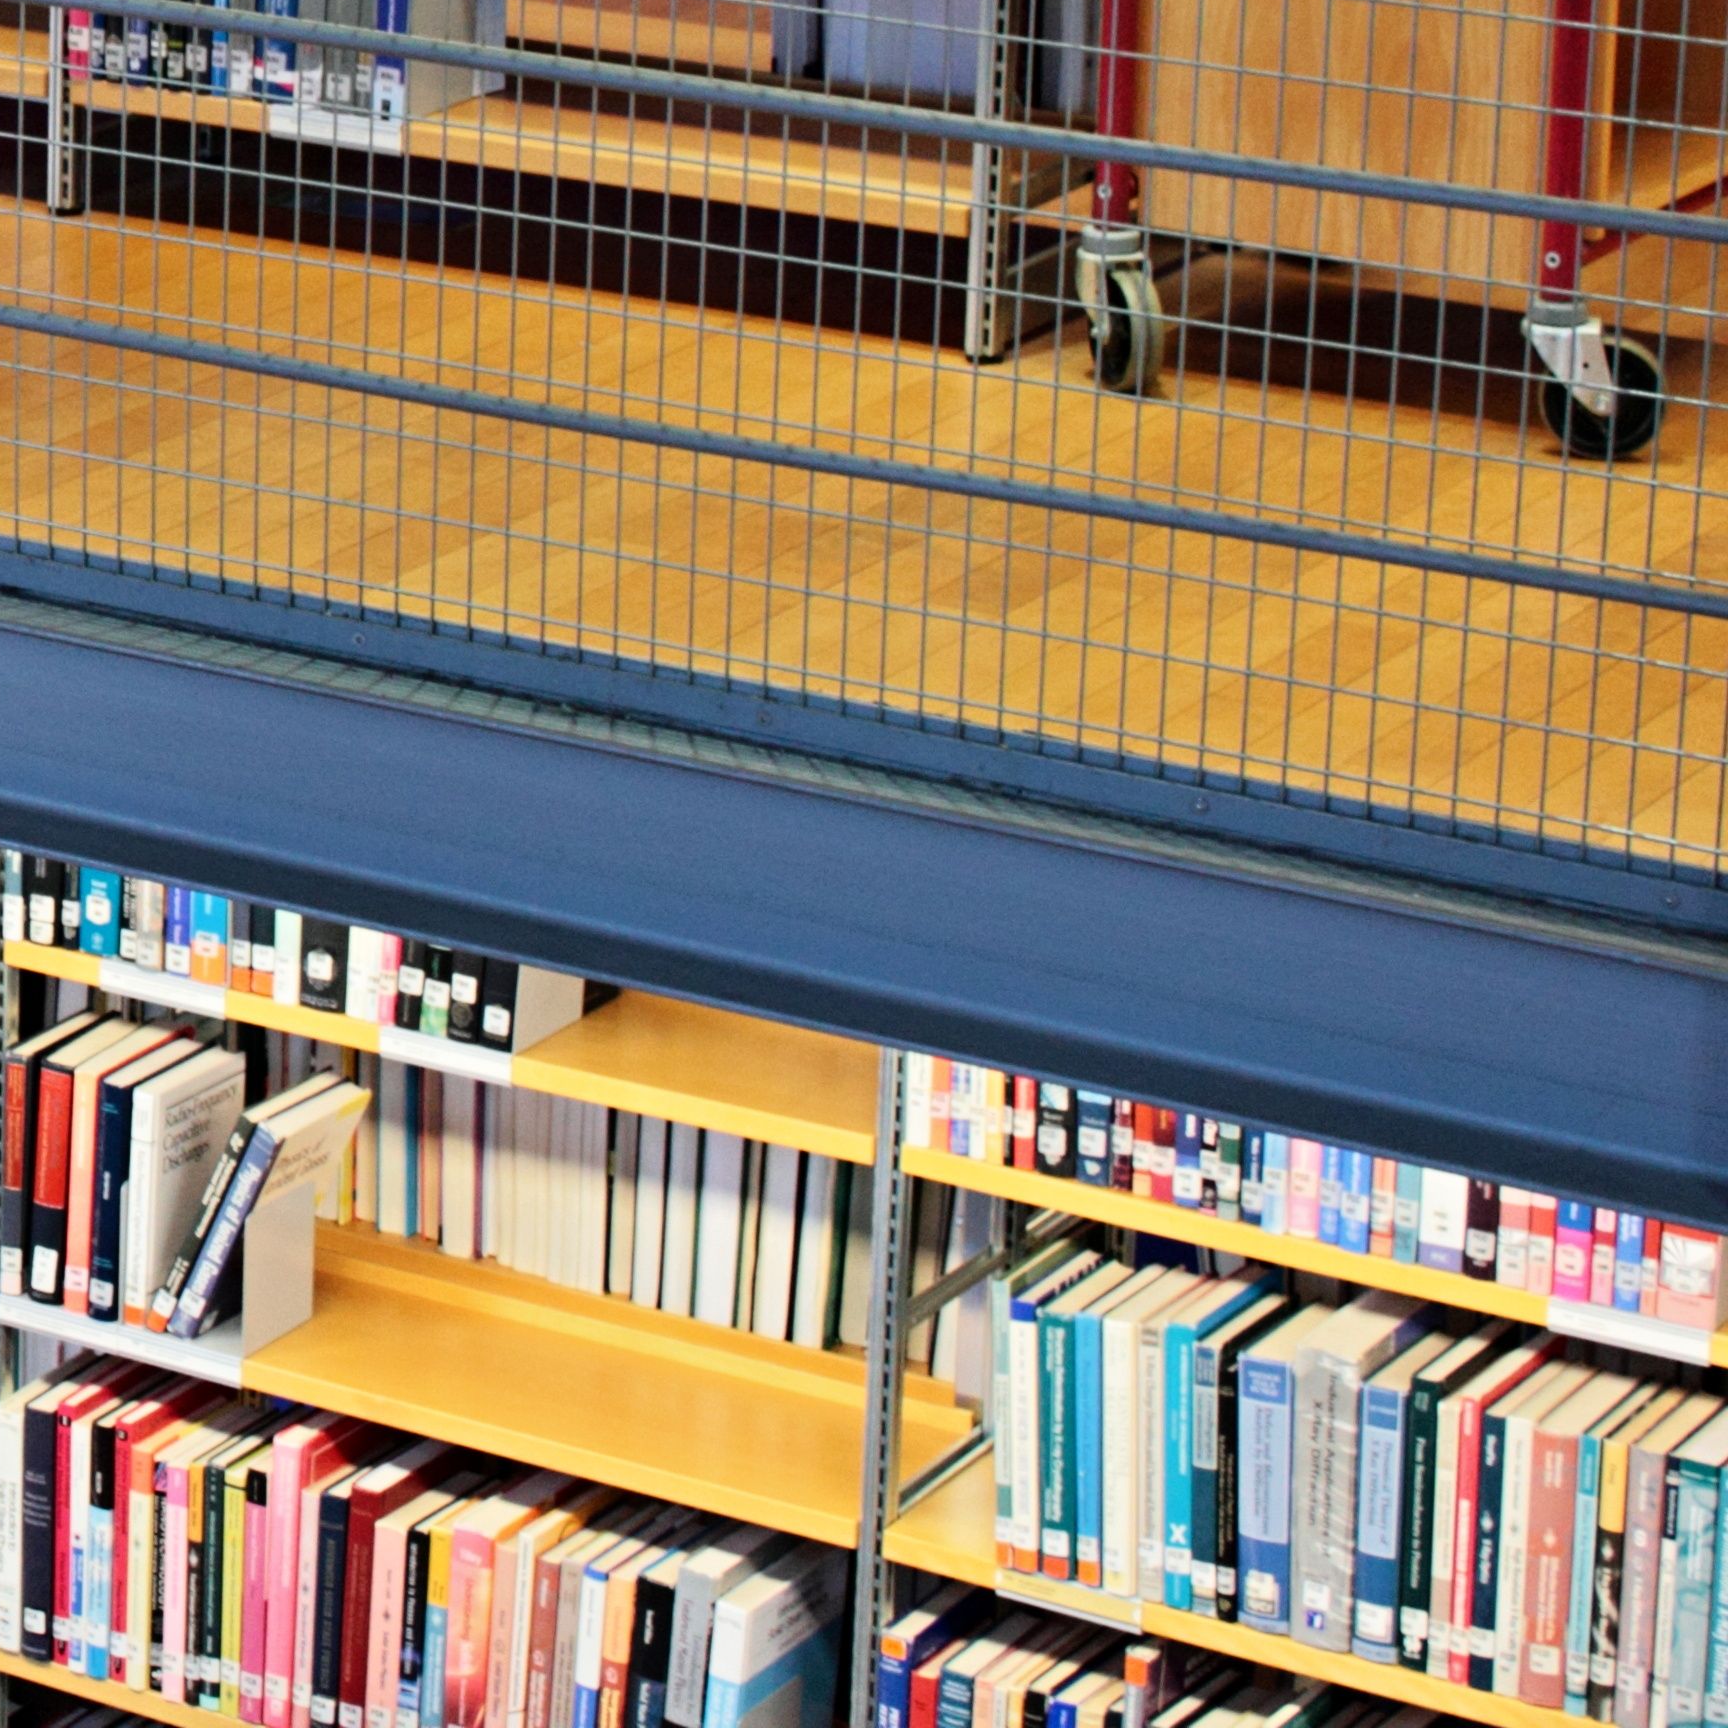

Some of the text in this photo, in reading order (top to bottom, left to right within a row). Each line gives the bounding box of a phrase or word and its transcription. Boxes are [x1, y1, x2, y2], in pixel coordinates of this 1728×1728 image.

[1308, 1448, 1322, 1527] Diffraction
[1321, 1376, 1339, 1539] Industrial Applications
